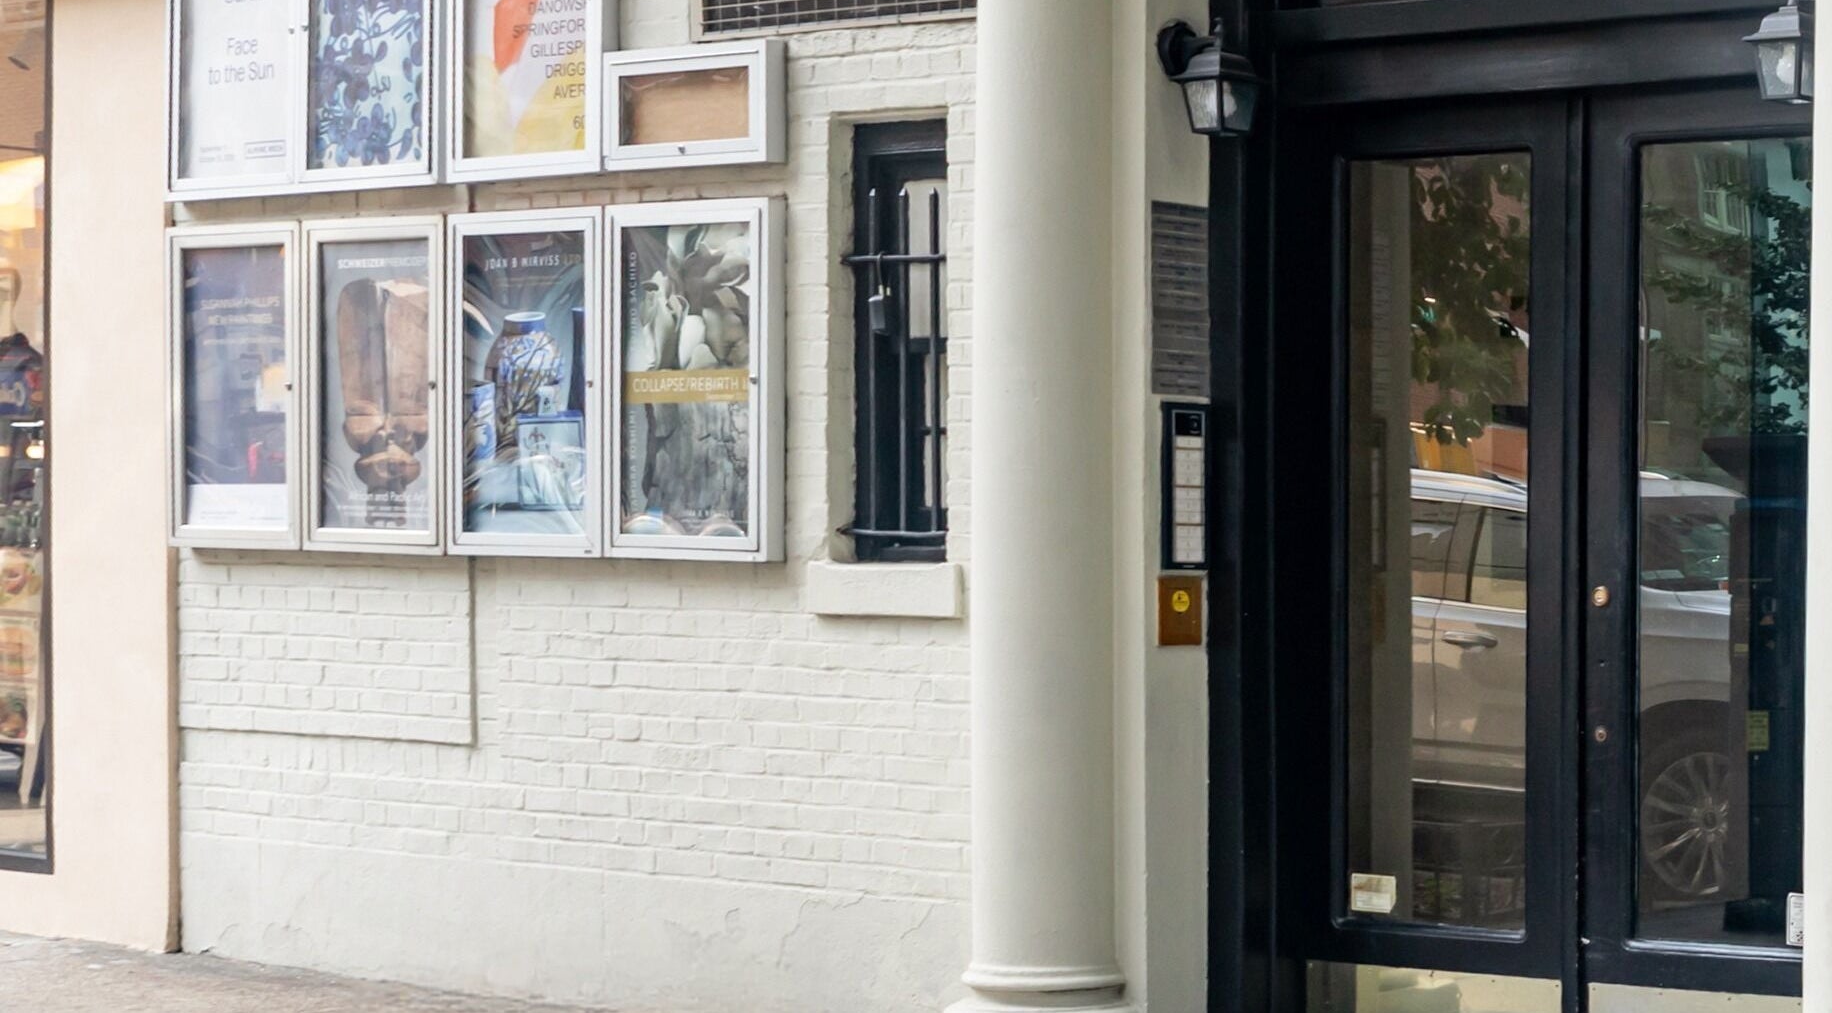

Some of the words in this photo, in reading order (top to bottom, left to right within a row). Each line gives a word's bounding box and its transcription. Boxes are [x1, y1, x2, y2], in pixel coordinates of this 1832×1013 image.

[227, 37, 258, 56] Face
[208, 67, 221, 85] to
[224, 63, 246, 83] the
[248, 61, 274, 81] Sun
